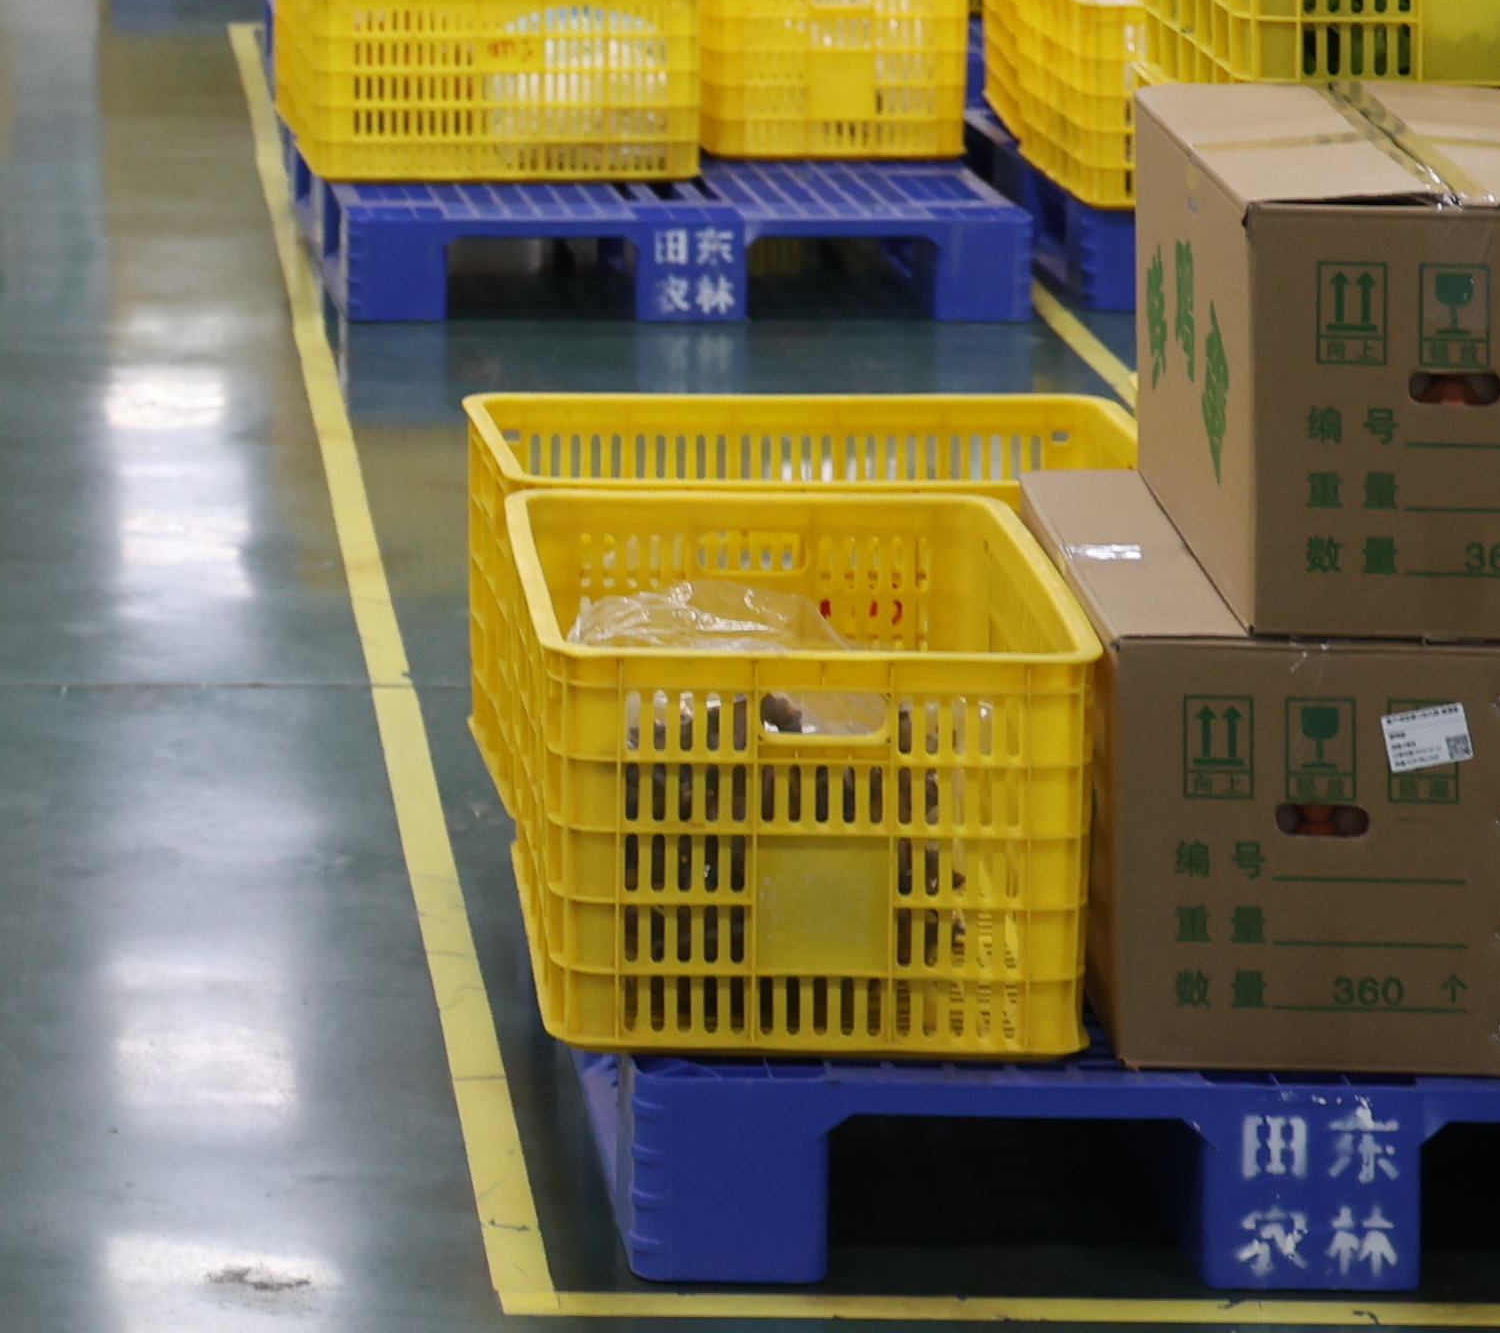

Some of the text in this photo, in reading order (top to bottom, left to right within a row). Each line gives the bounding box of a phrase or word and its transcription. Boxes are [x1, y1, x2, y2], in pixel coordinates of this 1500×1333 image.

[654, 226, 735, 266] 田东
[1307, 406, 1398, 444] 编号
[1306, 472, 1398, 509] 重量
[1306, 536, 1398, 574] 数量
[1175, 841, 1267, 878] 编号
[1175, 905, 1267, 944] 重量
[1175, 970, 1267, 1007] 数量
[1333, 976, 1404, 1006] 360
[1242, 1101, 1400, 1183] 田东
[1236, 1203, 1399, 1276] 农林
